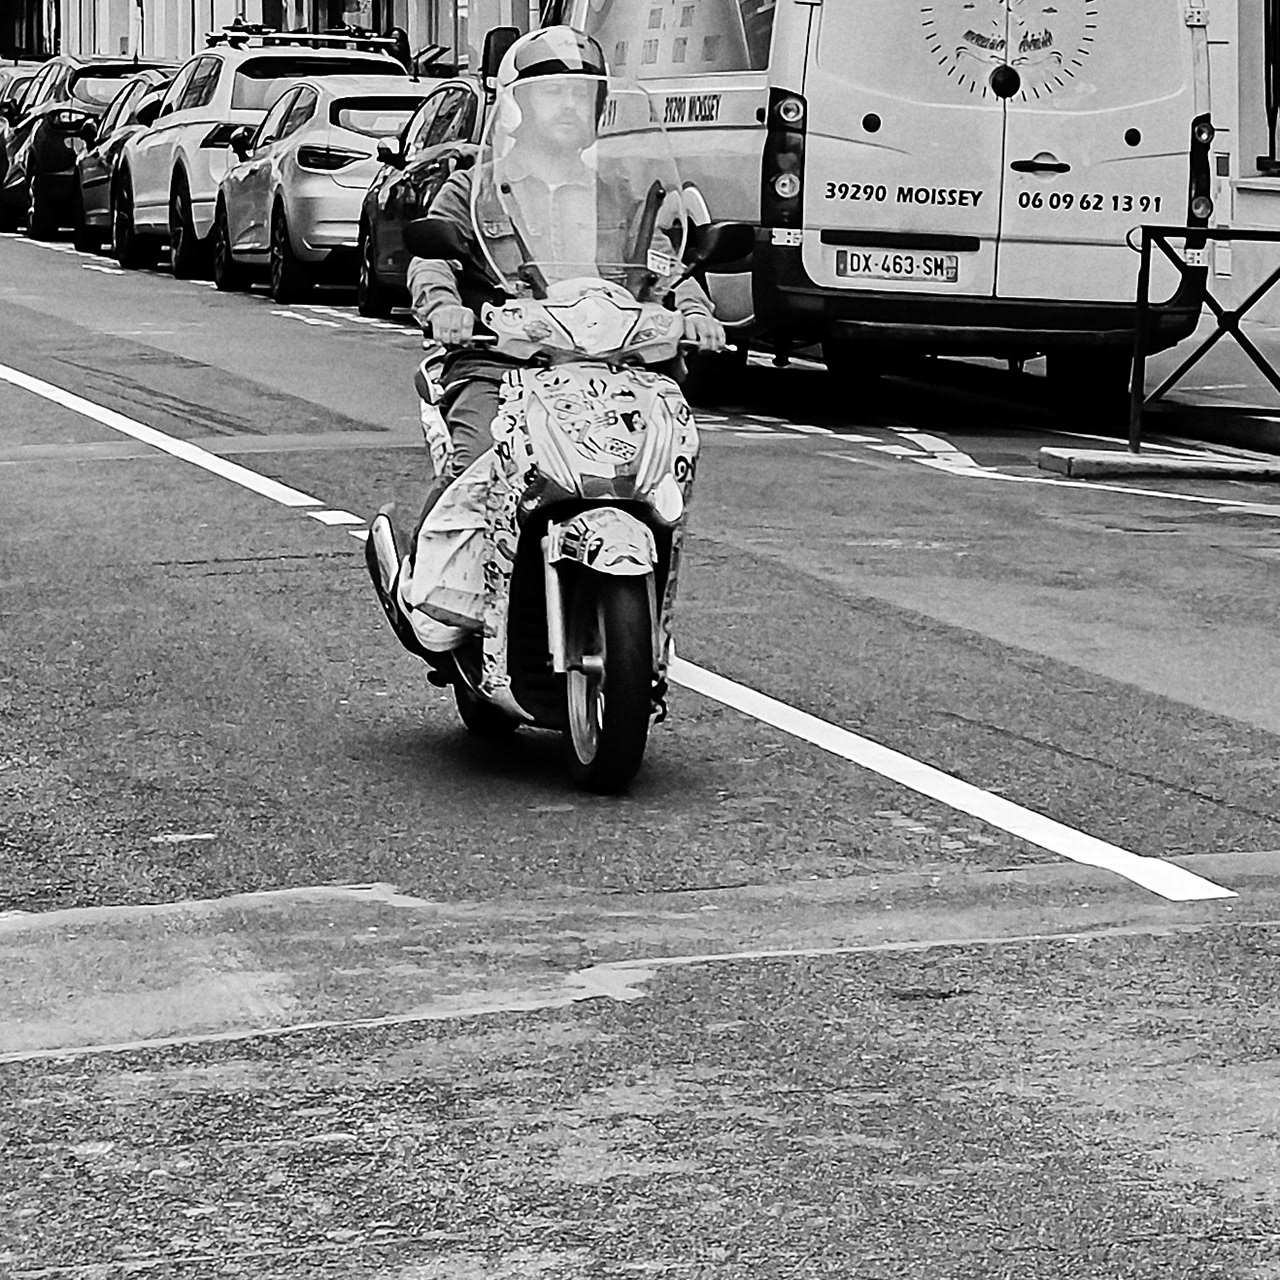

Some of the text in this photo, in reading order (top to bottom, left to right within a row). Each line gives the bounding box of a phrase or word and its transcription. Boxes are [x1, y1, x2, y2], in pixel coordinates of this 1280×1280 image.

[824, 182, 983, 207] 39290 MOISSEY
[1018, 191, 1162, 213] 06 09 62 13 91
